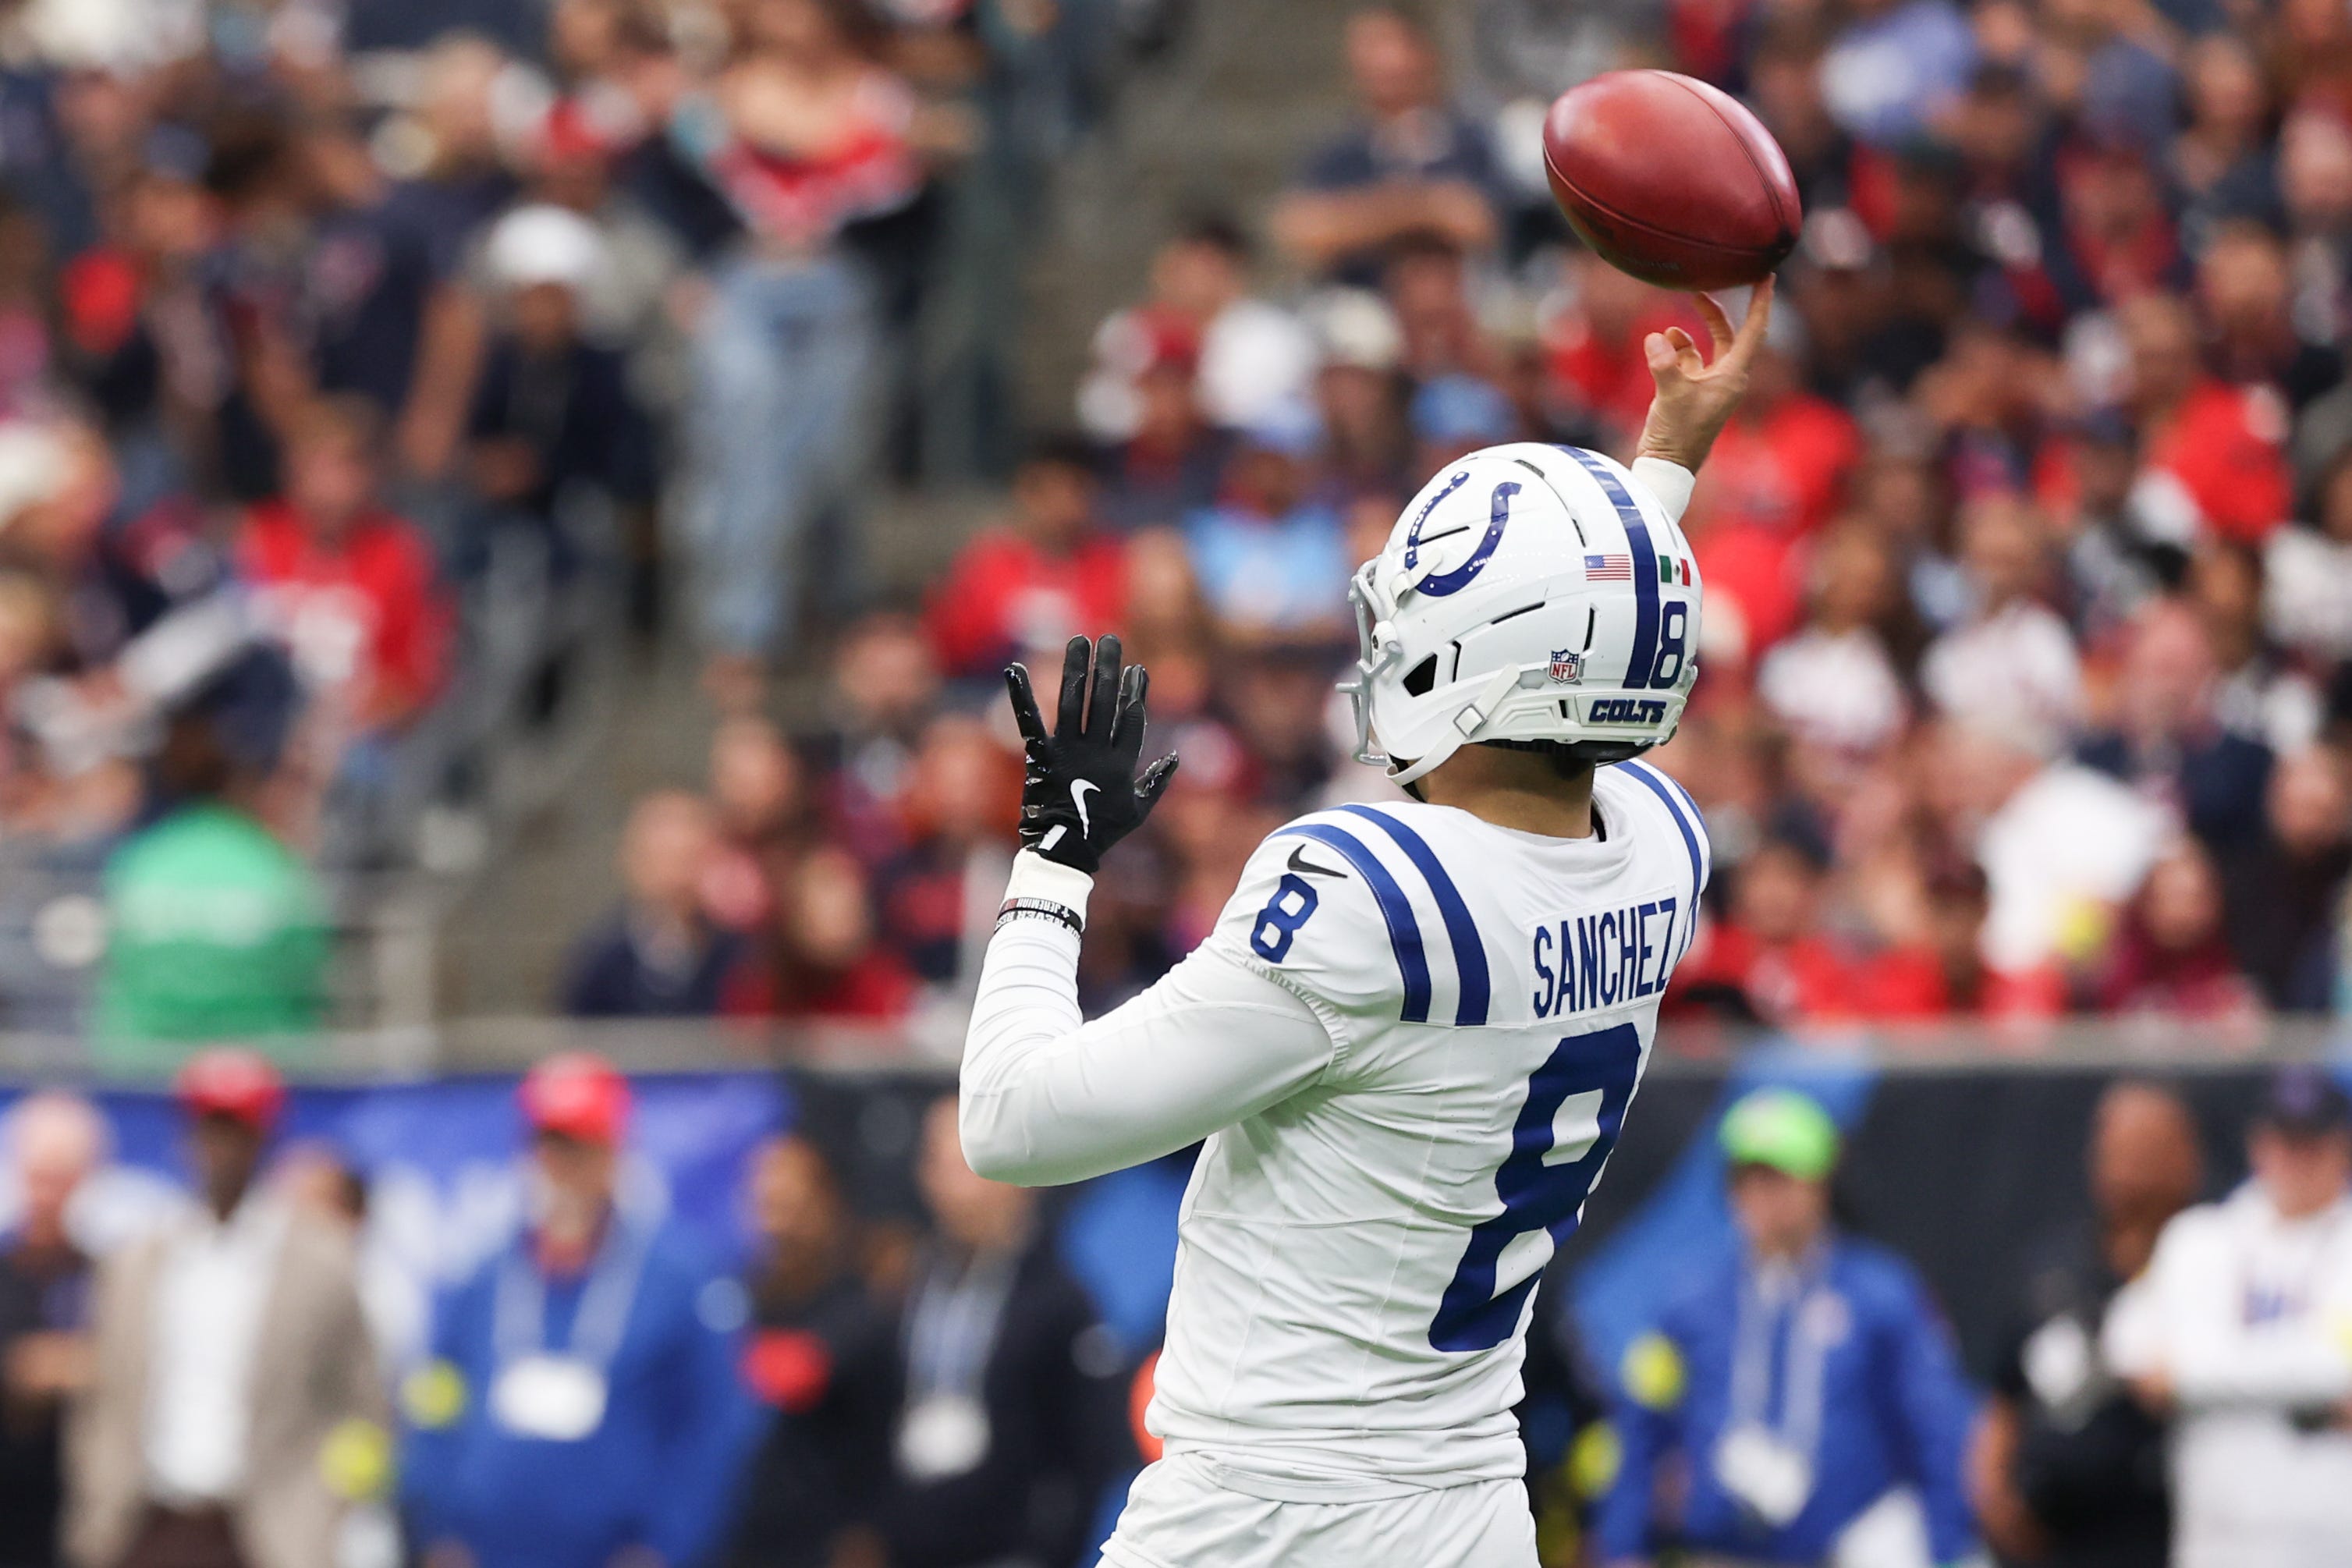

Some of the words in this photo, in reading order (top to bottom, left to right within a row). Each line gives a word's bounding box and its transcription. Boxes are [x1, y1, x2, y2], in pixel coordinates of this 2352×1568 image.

[1552, 662, 1575, 679] NFL
[1649, 601, 1687, 690] 8
[1588, 699, 1667, 723] COLTS
[1016, 898, 1062, 914] JEREMIAH
[1250, 872, 1319, 964] 8
[1532, 896, 1678, 1020] SANCHEZ
[1427, 1021, 1642, 1353] 8
